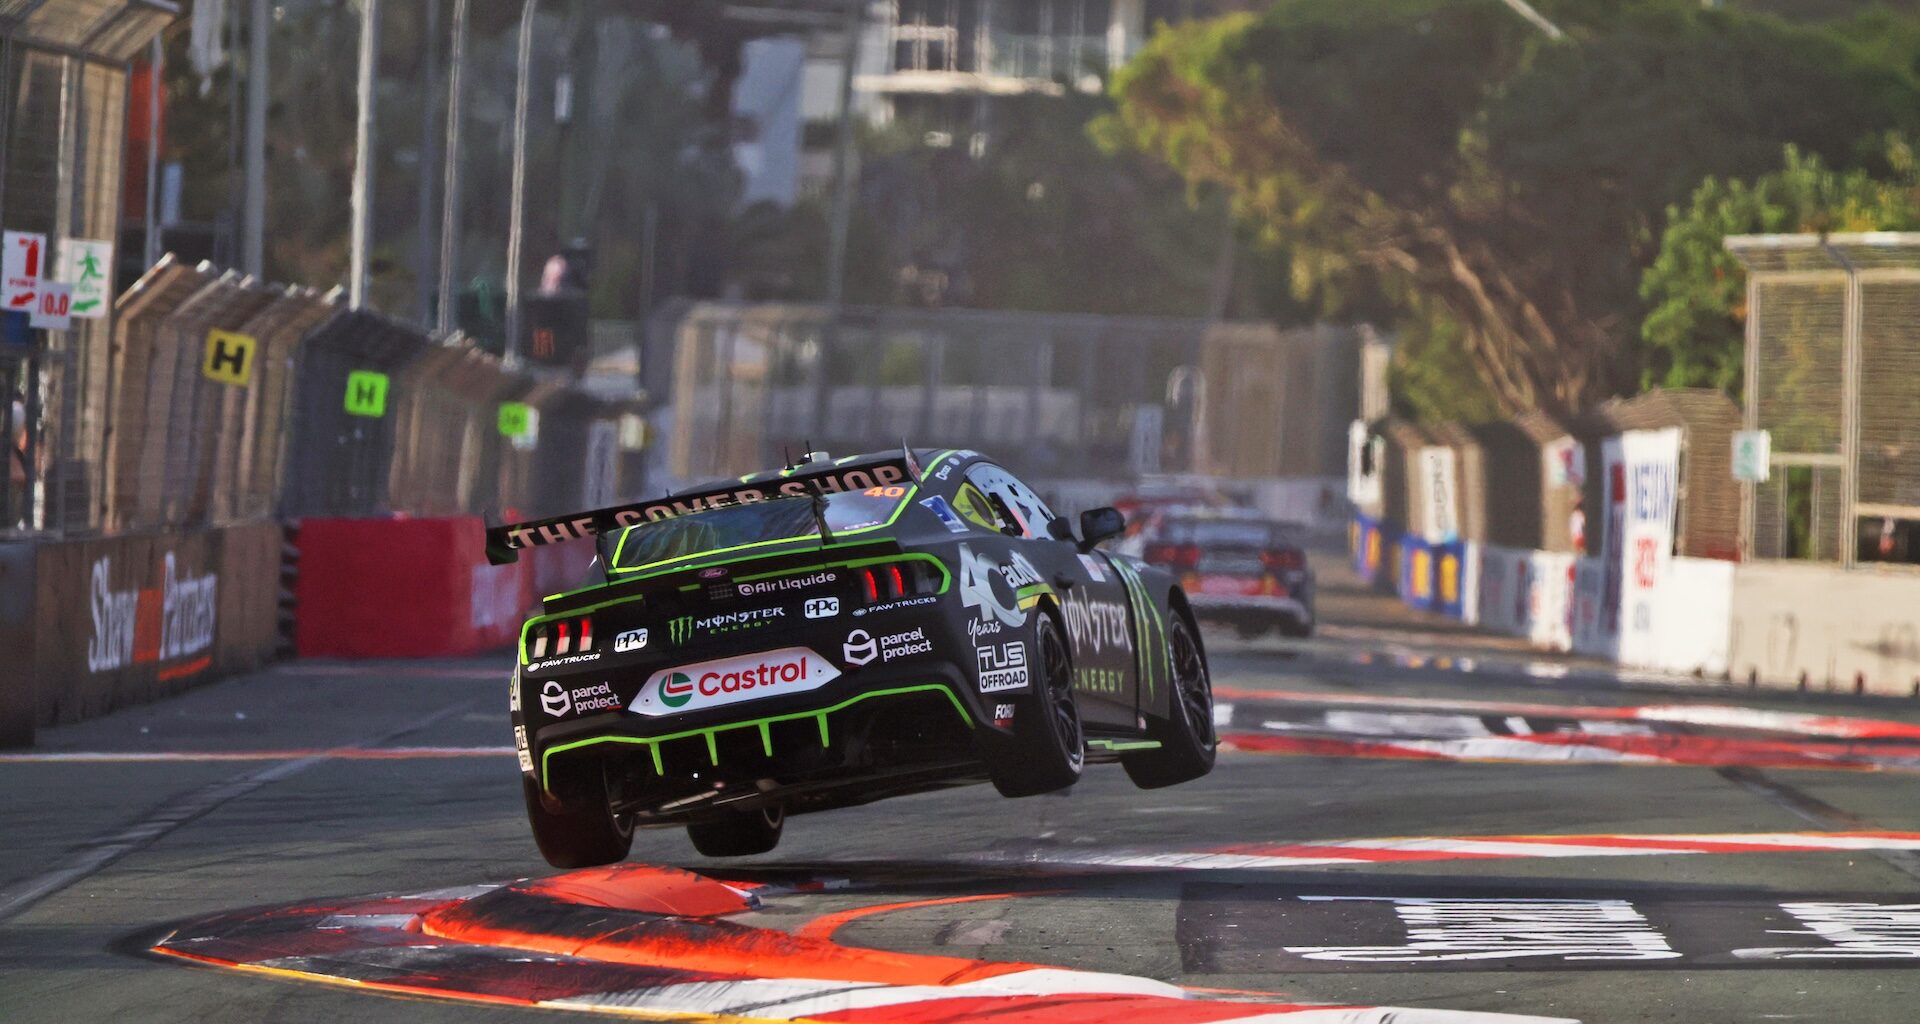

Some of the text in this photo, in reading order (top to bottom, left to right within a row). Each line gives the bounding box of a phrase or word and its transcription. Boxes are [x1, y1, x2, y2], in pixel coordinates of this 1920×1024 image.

[211, 339, 245, 374] H
[356, 380, 376, 405] H
[864, 486, 905, 497] 40
[508, 517, 597, 548] THE
[755, 572, 836, 594] Air Liquide
[806, 599, 838, 615] PPG
[869, 596, 937, 614] FAW TRUCKS
[710, 620, 772, 635] ENERGY
[880, 627, 924, 649] parcel
[968, 617, 1001, 647] Years
[616, 632, 646, 648] PPG
[882, 639, 932, 662] protect
[541, 653, 601, 669] FAW TRUCKS
[978, 642, 1026, 669] TUS
[698, 656, 807, 696] Castrol
[981, 670, 1027, 689] OFFROAD
[572, 681, 611, 701] parcel
[574, 693, 620, 714] protect
